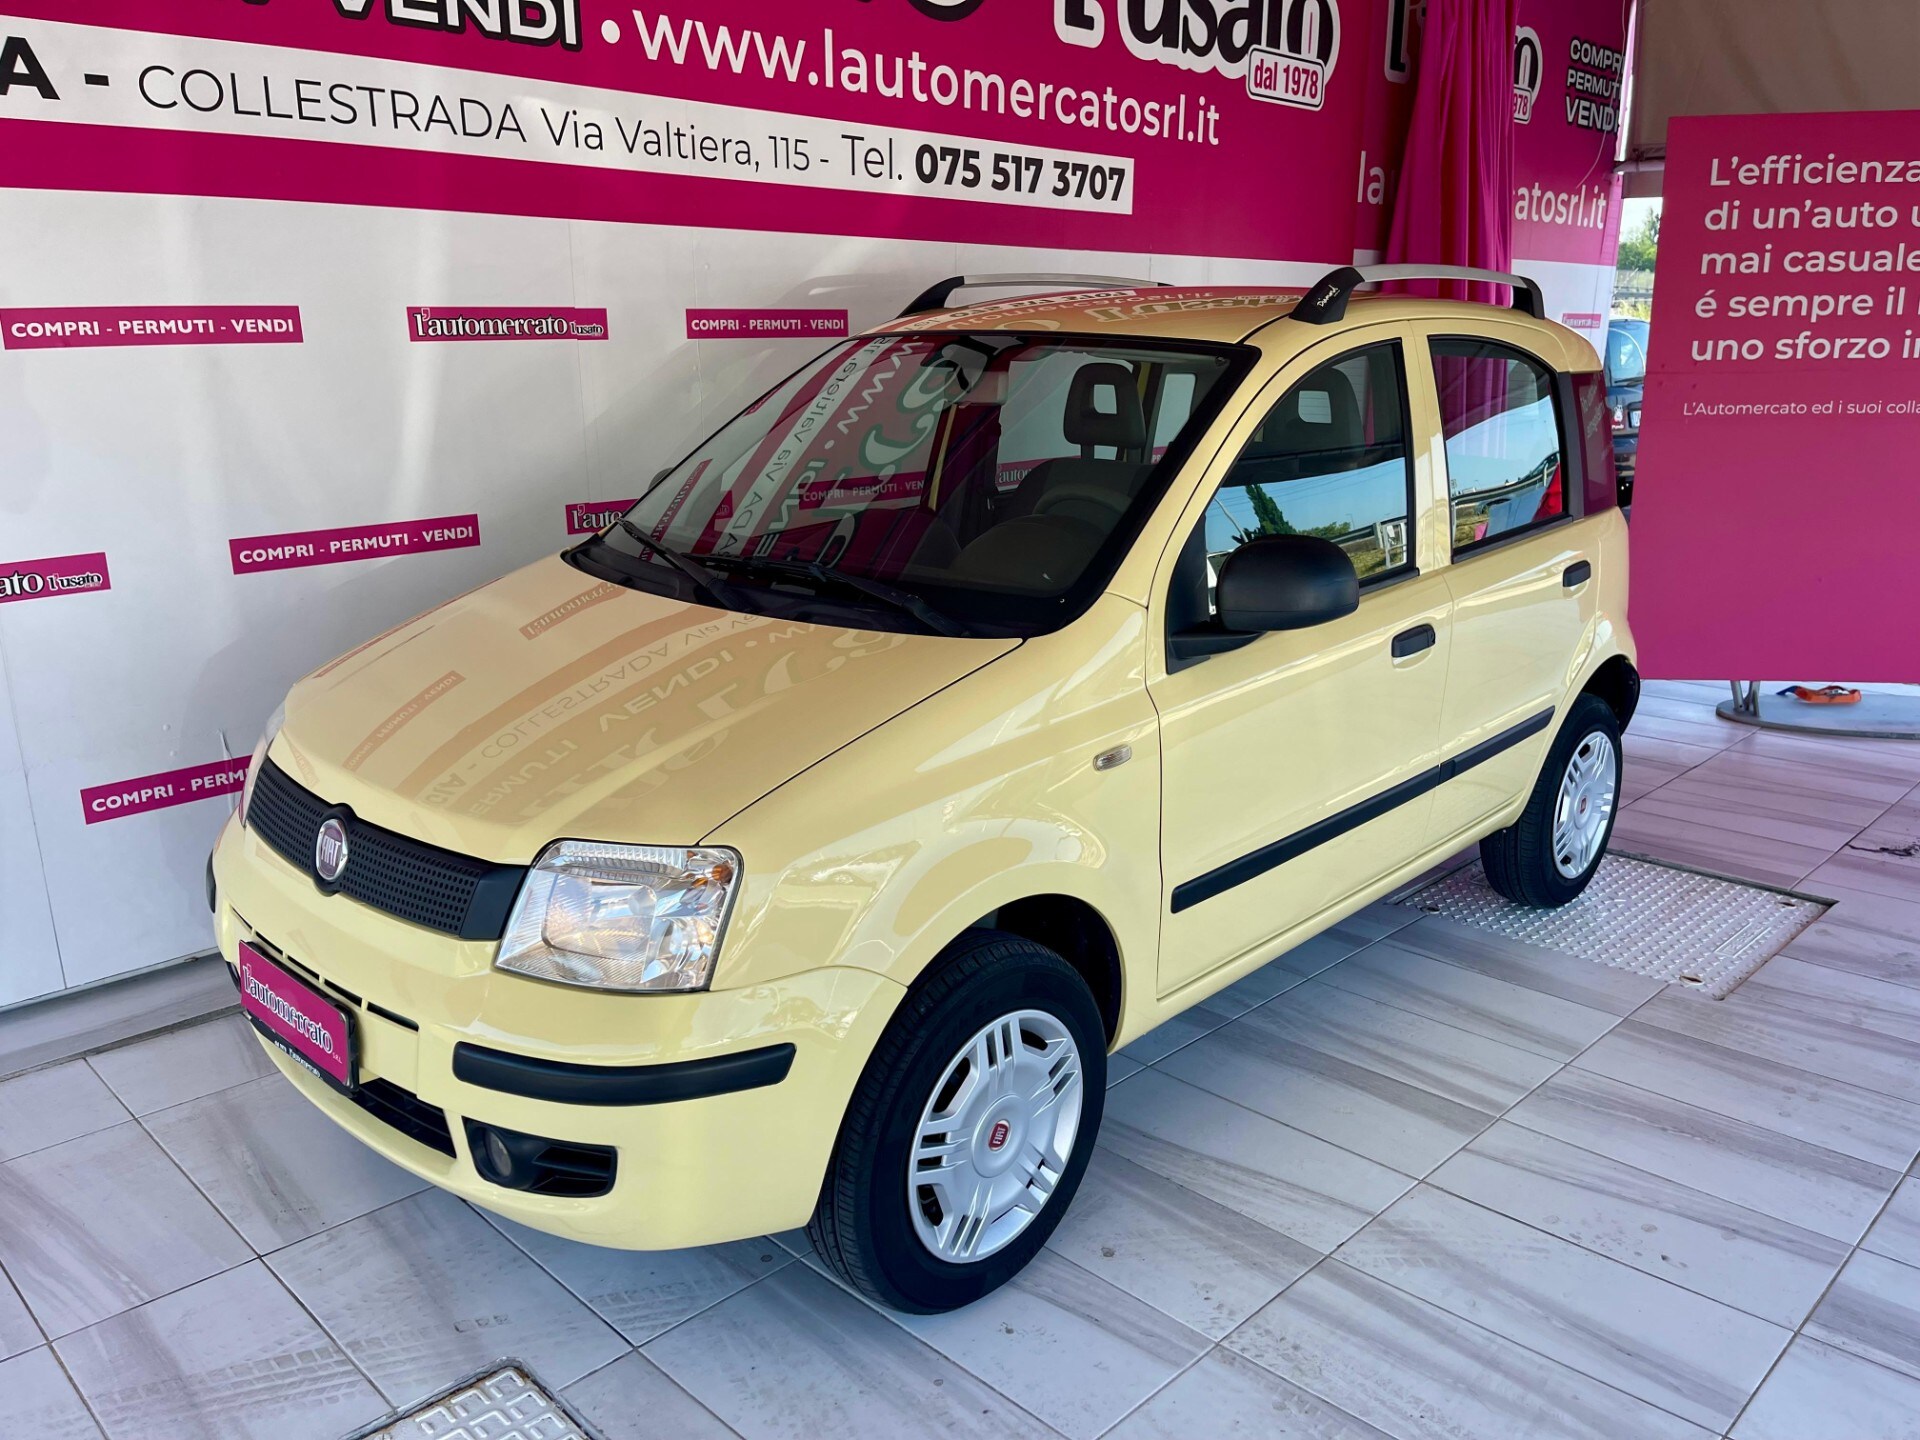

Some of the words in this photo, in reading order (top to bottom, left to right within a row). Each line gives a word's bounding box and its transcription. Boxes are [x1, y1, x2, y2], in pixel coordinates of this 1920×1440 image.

[632, 9, 1220, 146] www.lautomercatosrl.it
[1253, 58, 1278, 92] dal
[1282, 64, 1319, 99] 1978
[138, 65, 527, 143] COLLESTRADA
[540, 107, 604, 151] Via
[614, 116, 761, 175] Valtiera,
[768, 135, 811, 171] 115
[841, 133, 903, 181] Tel.
[914, 143, 982, 189] 075
[991, 153, 1044, 194] 517
[1051, 164, 1127, 202] 3707
[1704, 199, 1740, 231] di
[1752, 199, 1898, 230] un'auto
[1700, 244, 1772, 275] mai
[1783, 242, 1920, 273] casuale
[1695, 289, 1717, 318] é
[1727, 293, 1874, 323] sempre
[1885, 286, 1906, 316] il
[11, 320, 100, 338] COMPRI
[119, 319, 215, 335] PERMUTI
[230, 318, 294, 333] VENDI
[414, 307, 568, 337] l'automercato
[691, 319, 740, 331] COMPRI
[749, 319, 801, 331] PERMUTI
[810, 319, 844, 330] VENDI
[1691, 338, 1764, 361] uno
[1774, 331, 1891, 360] sforzo
[1683, 402, 1807, 416] L'Automercato
[1811, 400, 1834, 415] ed
[1838, 401, 1843, 414] i
[1846, 400, 1883, 415] suoi
[239, 543, 314, 565] COMPRI
[329, 533, 409, 554] PERMUTI
[422, 525, 473, 543] VENDI
[91, 783, 174, 813] COMPRI
[320, 834, 342, 868] FIAT
[242, 963, 333, 1054] l'automercato
[992, 1126, 1006, 1145] FIAT
